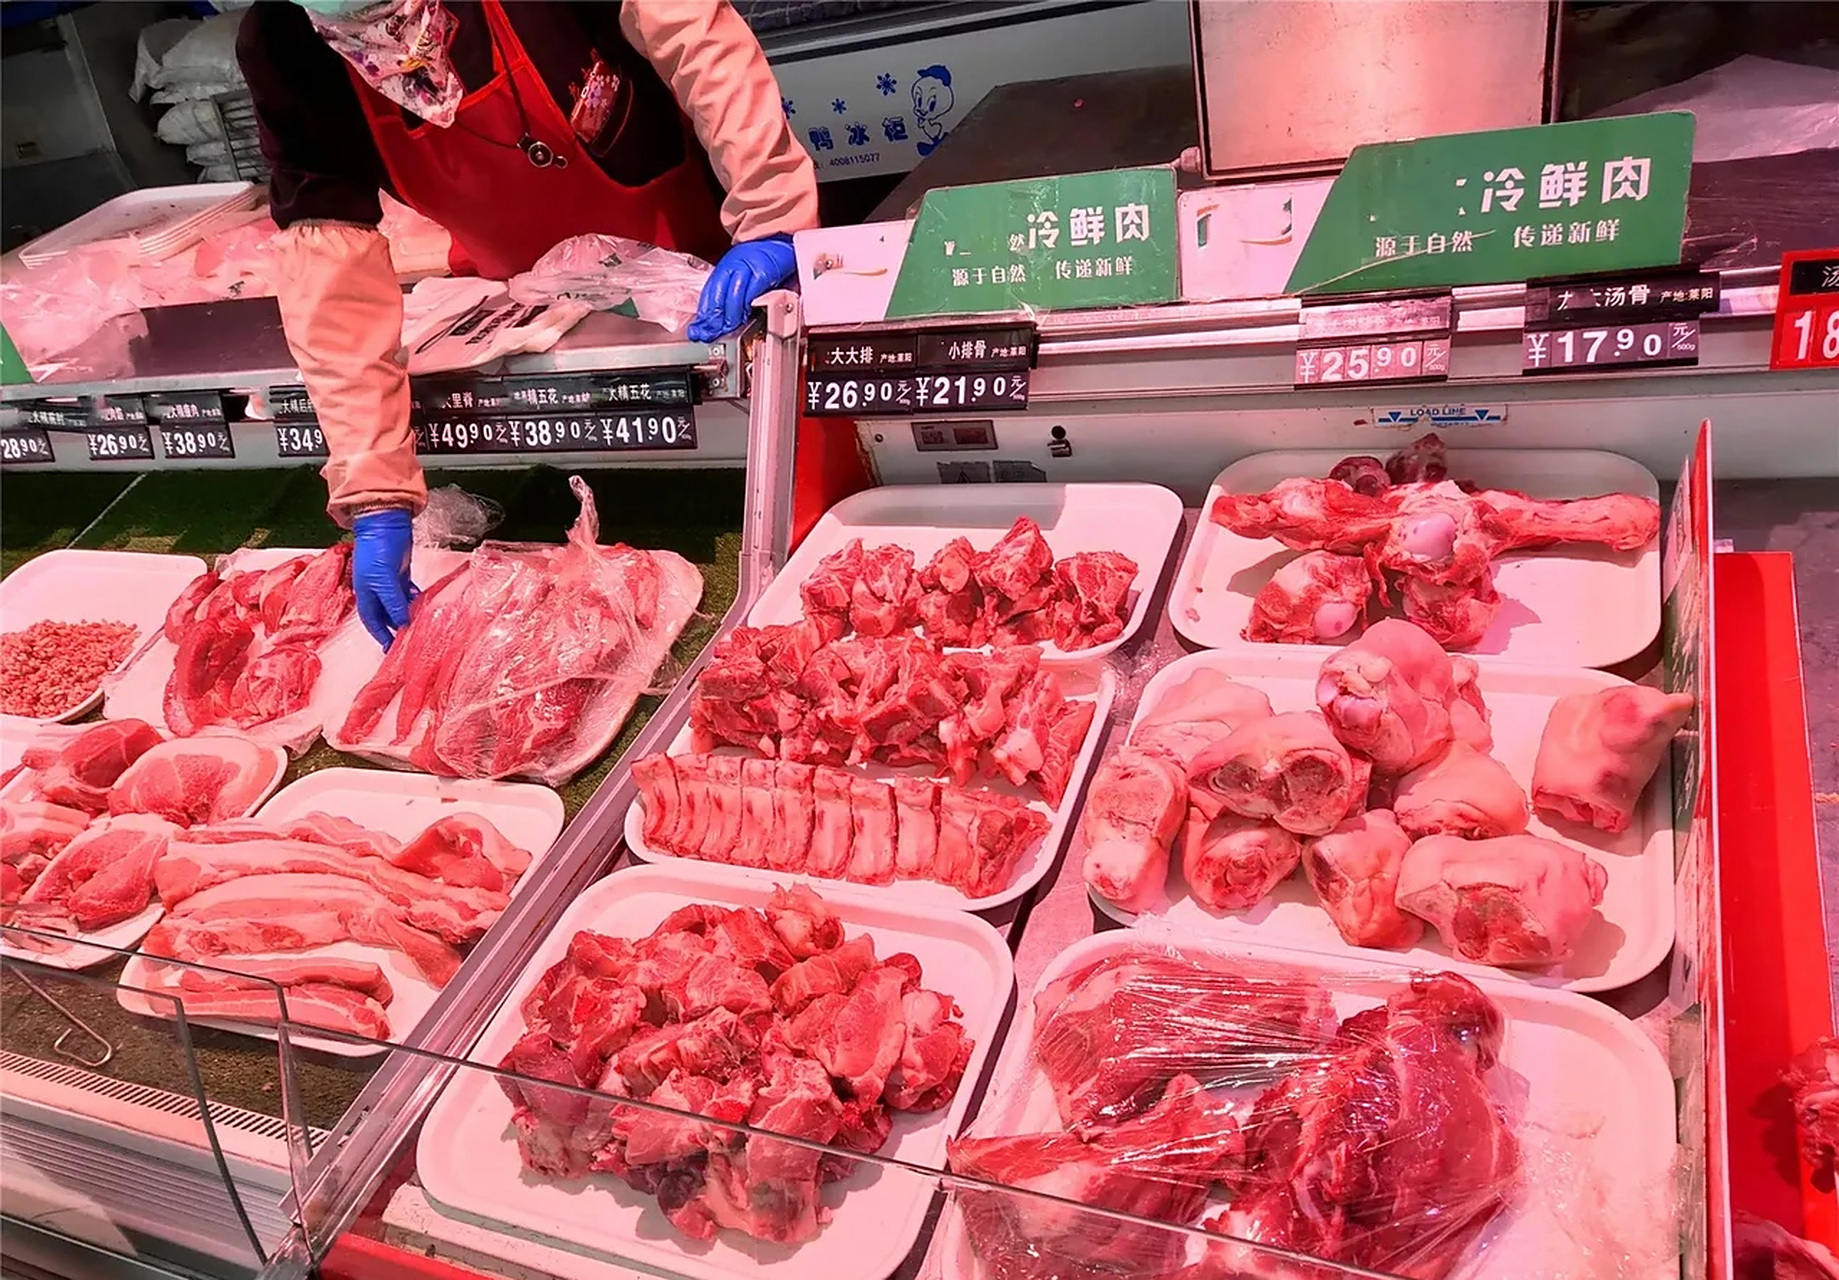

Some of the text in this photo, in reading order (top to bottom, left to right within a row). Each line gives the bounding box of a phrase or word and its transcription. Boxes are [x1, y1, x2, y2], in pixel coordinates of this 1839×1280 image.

[1480, 156, 1652, 214] 冷鲜肉
[1026, 203, 1150, 250] 冷鲜肉
[1375, 218, 1620, 258] 源于自然 传递新鲜
[952, 256, 1133, 287] 源于自然 传递新鲜
[948, 339, 987, 360] 小排骨
[1527, 328, 1662, 368] ¥17.90
[1300, 347, 1417, 384] ¥25.90
[807, 380, 893, 411] ¥26.90
[915, 375, 1006, 407] ¥21.90
[1410, 406, 1467, 417] LOAD LINE
[87, 433, 137, 456] ¥26.90
[161, 430, 216, 455] ¥38.90
[428, 422, 493, 449] ¥49.90
[508, 420, 581, 448] ¥38.90
[599, 416, 677, 447] ¥41.90
